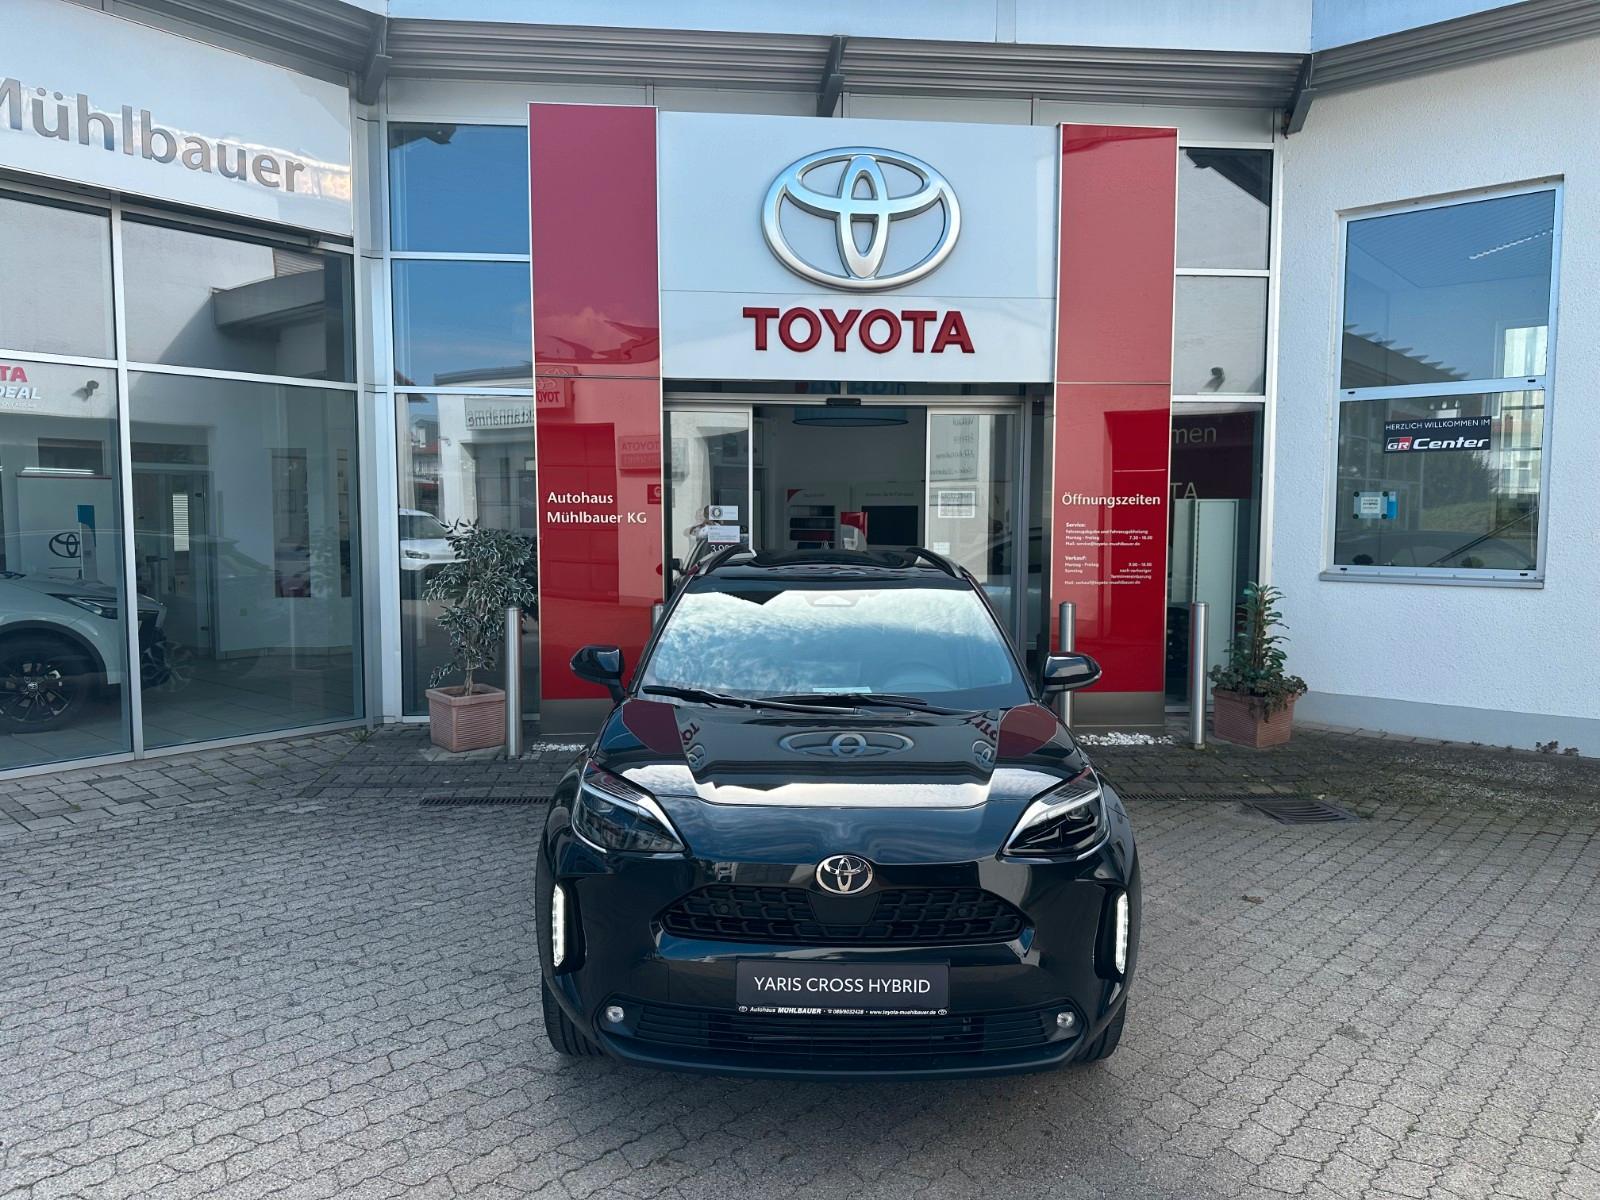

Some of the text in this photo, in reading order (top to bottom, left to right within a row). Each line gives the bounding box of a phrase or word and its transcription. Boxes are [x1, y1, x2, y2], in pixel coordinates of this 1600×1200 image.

[743, 306, 976, 354] TOYOTA
[1385, 422, 1422, 431] HERZLICH
[1424, 420, 1479, 429] WILLKOMMEN
[1387, 436, 1489, 450] GR Center
[547, 491, 614, 504] Autohaus
[1062, 491, 1161, 508] Öffnungszeiten
[547, 511, 647, 524] Mühlbauer KG
[754, 976, 931, 993] YARIS CROSS HYBRID
